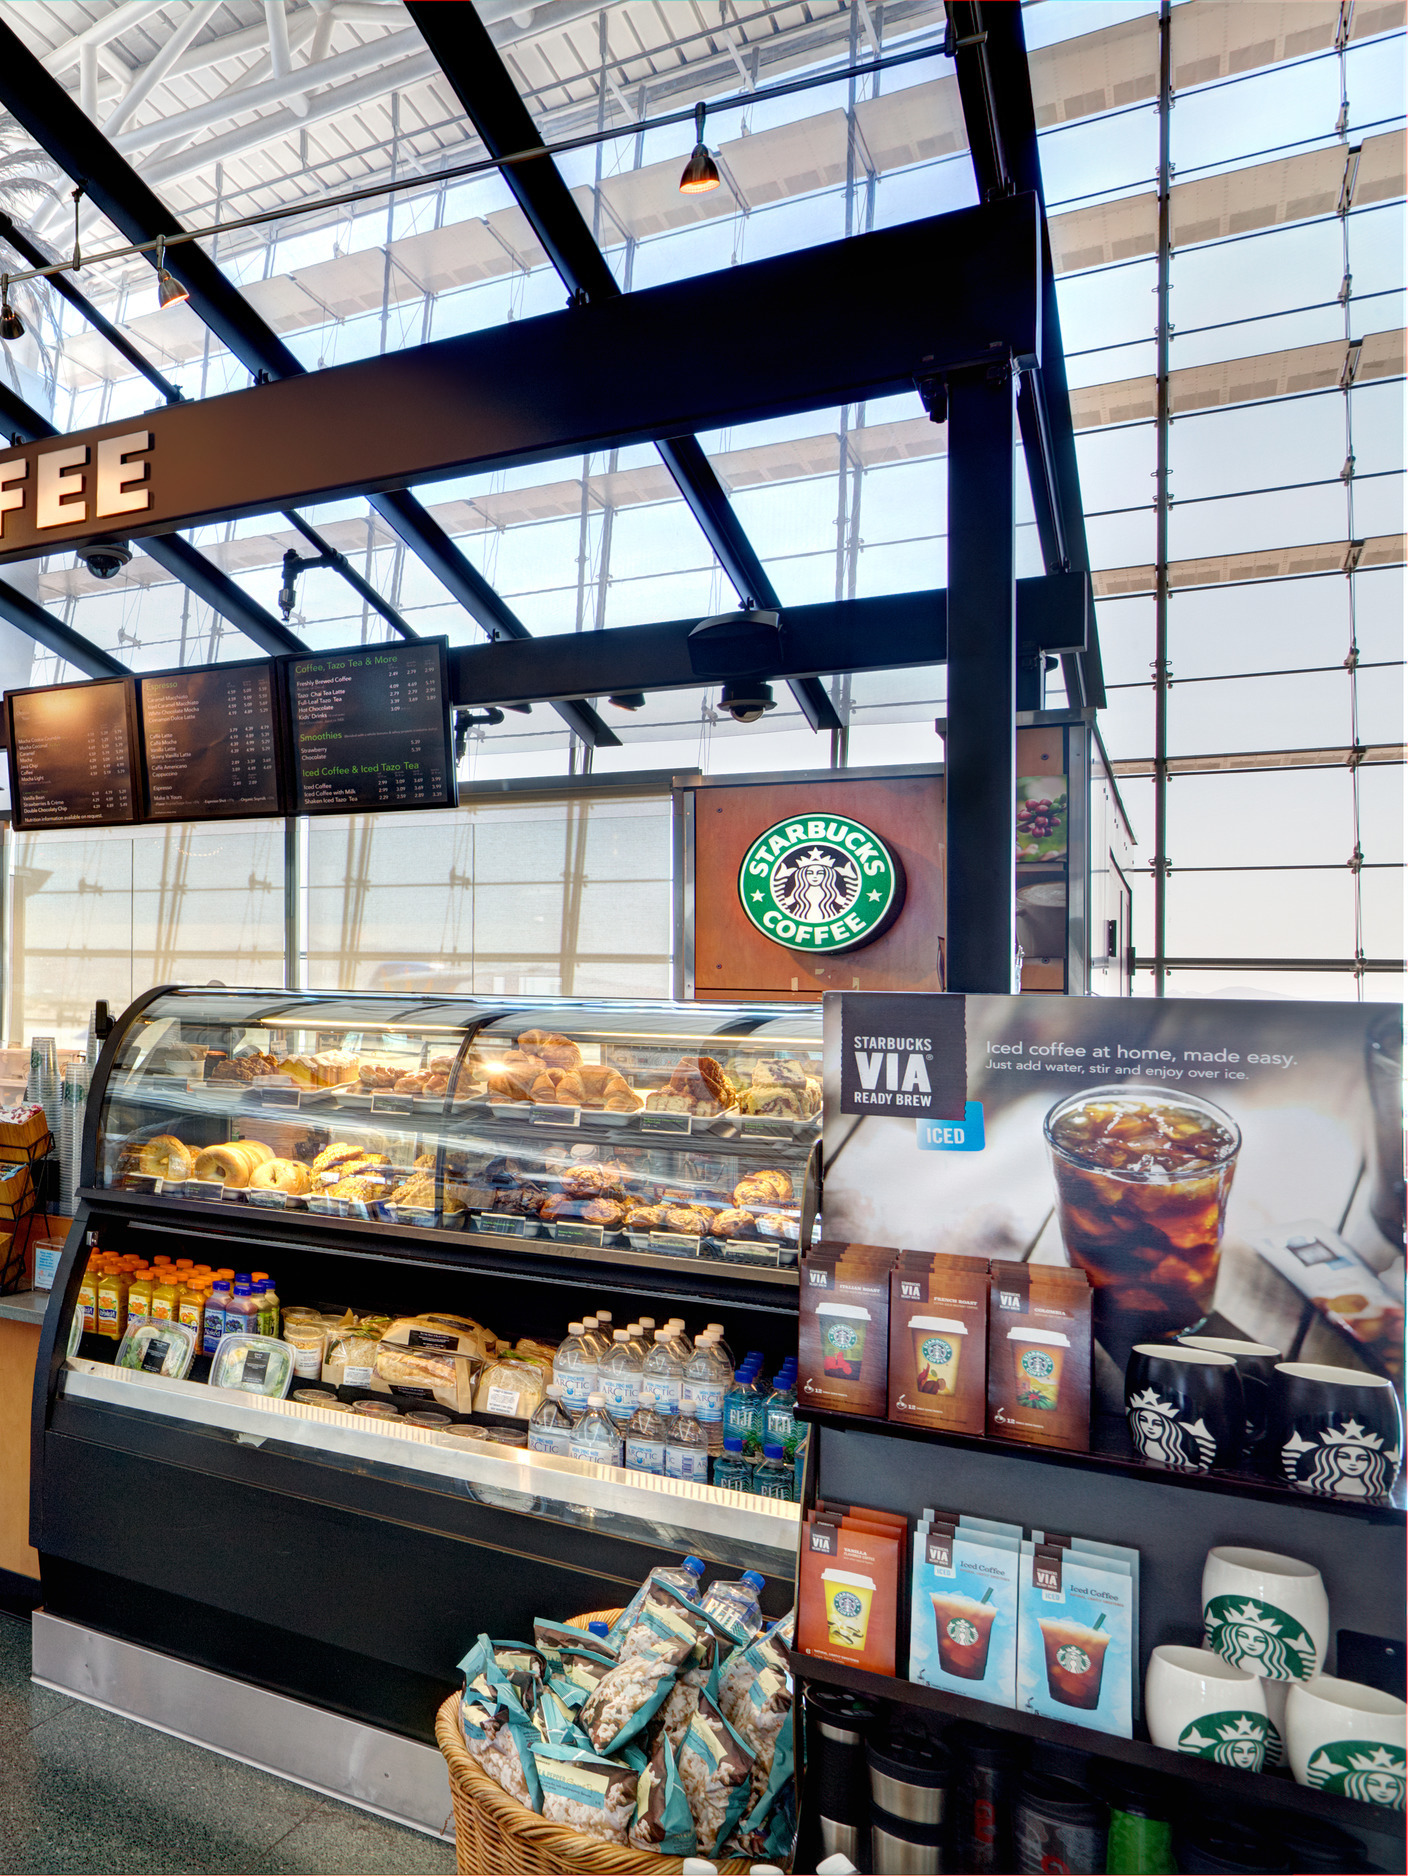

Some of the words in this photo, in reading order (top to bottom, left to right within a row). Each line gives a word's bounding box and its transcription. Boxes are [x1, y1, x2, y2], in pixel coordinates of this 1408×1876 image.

[296, 664, 325, 674] Coffee,
[327, 662, 345, 670] Tazo
[348, 659, 362, 668] Tea
[365, 657, 372, 665] &
[374, 656, 398, 664] More
[146, 682, 178, 691] Espresso
[300, 732, 342, 742] Smoothies
[302, 768, 320, 777] Iced
[322, 765, 350, 776] Coffee
[352, 765, 358, 773] &
[360, 764, 379, 772] Iced
[381, 763, 400, 771] Tazo
[403, 761, 419, 770] Tea
[748, 820, 885, 879] STARBUCKS
[762, 910, 868, 945] COFFEE
[854, 1036, 932, 1051] STARBUCKS
[986, 1041, 1023, 1055] Iced
[1028, 1042, 1086, 1058] coffee
[1092, 1046, 1111, 1059] at
[1117, 1044, 1176, 1063] home,
[1183, 1048, 1240, 1064] made
[1246, 1052, 1298, 1069] easy.
[985, 1059, 1013, 1071] Just
[1016, 1060, 1041, 1072] add
[1045, 1062, 1085, 1075] water,
[1089, 1063, 1110, 1074] stir
[1114, 1065, 1141, 1076] and
[1145, 1066, 1183, 1080] enjoy
[1188, 1069, 1219, 1079] over
[1224, 1069, 1249, 1080] ice.
[854, 1092, 893, 1105] READY
[896, 1094, 932, 1107] BREW
[926, 1127, 965, 1144] ICED
[810, 1273, 827, 1284] VIA
[901, 1285, 920, 1296] VIA
[1000, 1295, 1020, 1307] VIA
[556, 1379, 589, 1389] ARCTIC
[602, 1386, 638, 1397] ARCTIC
[696, 1394, 724, 1402] ARCTI
[730, 1409, 752, 1427] FIJI
[768, 1415, 791, 1433] FIJI
[812, 1538, 830, 1549] VIA
[929, 1549, 948, 1562] VIA
[960, 1560, 977, 1571] Iced
[979, 1564, 1005, 1576] Coffee
[1036, 1572, 1057, 1586] VIA
[1070, 1585, 1088, 1595] Iced
[1090, 1589, 1119, 1601] Coffee
[704, 1598, 739, 1630] FIJI
